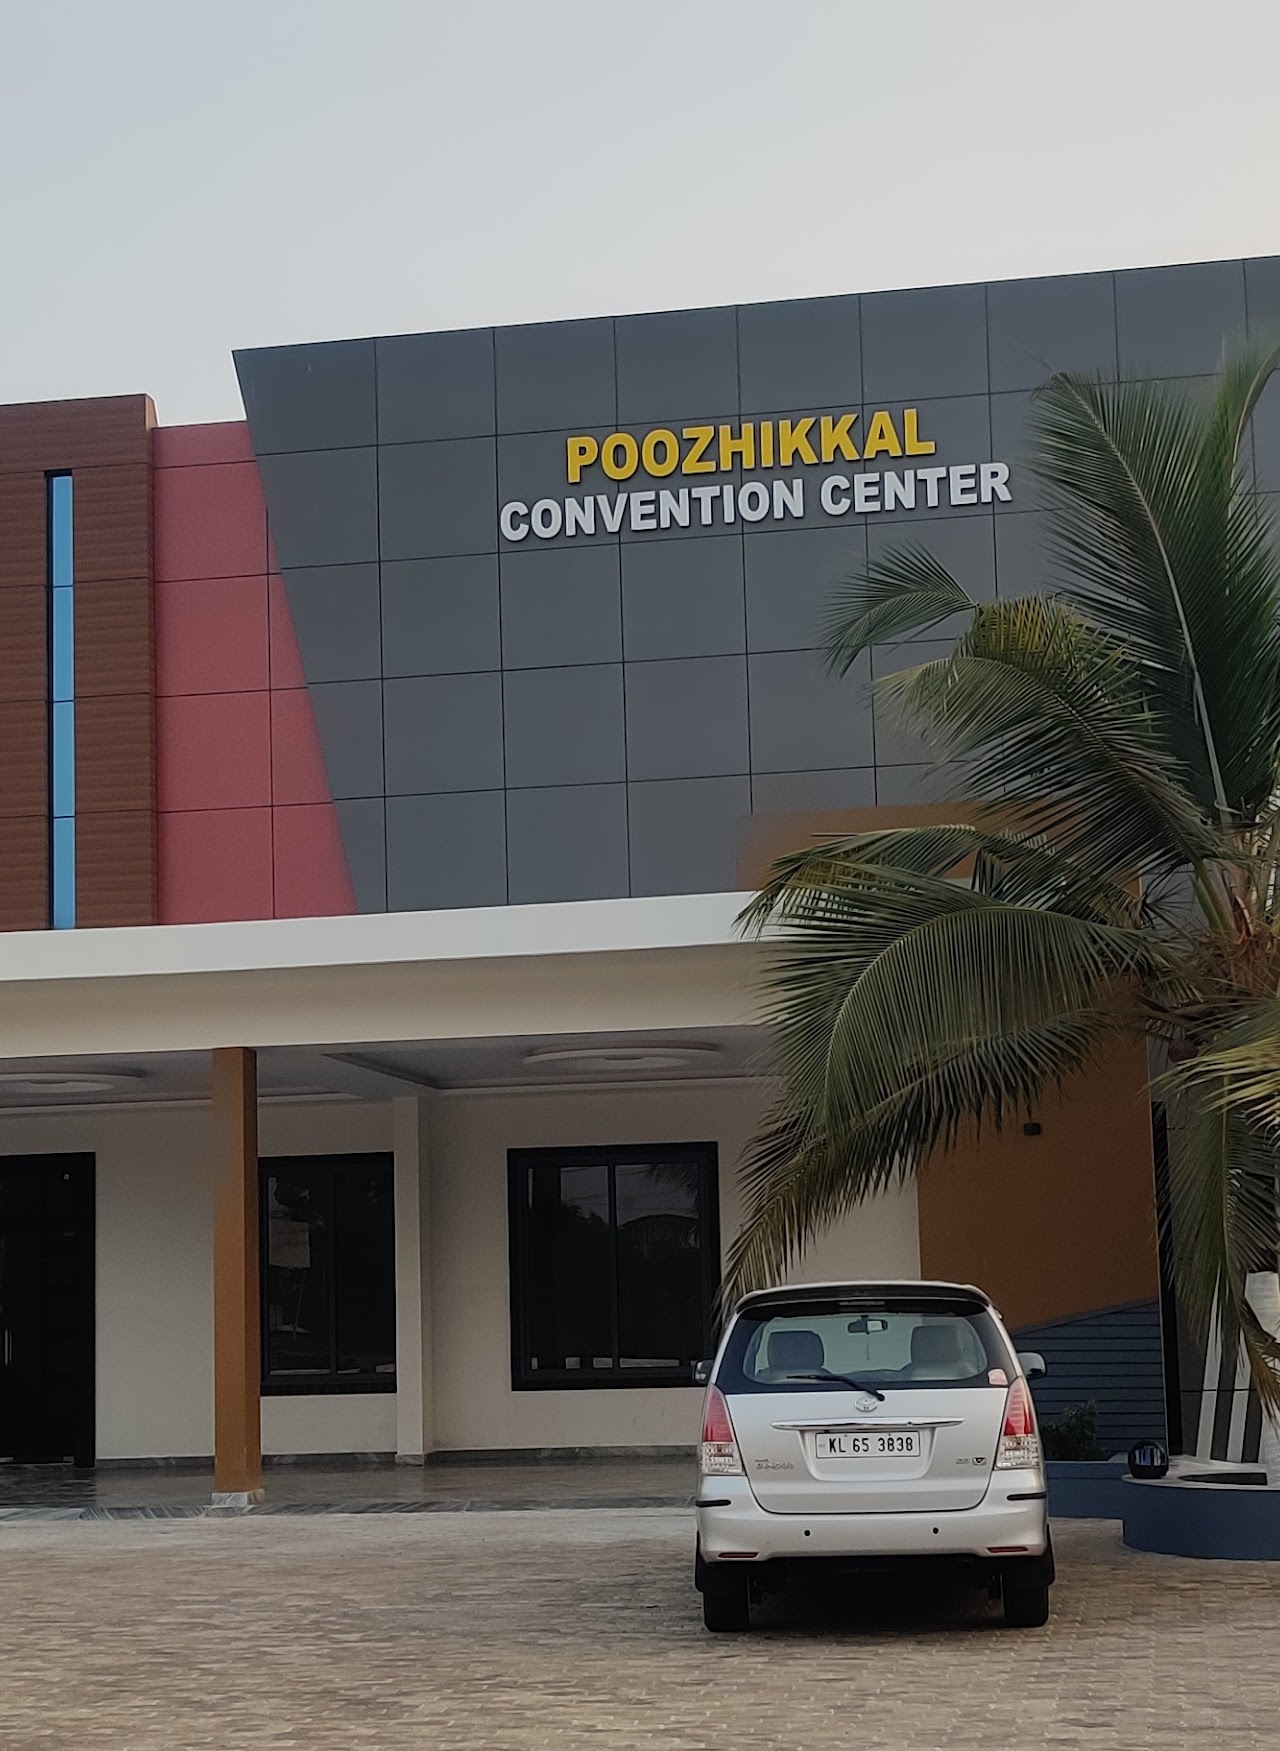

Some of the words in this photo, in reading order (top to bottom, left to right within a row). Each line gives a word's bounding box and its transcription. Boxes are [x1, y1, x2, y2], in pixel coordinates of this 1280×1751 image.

[566, 409, 936, 482] POOZHIKKAL
[500, 478, 804, 542] CONVENTION
[821, 462, 1013, 515] CENTER
[829, 1438, 846, 1453] KL
[852, 1438, 869, 1453] 65
[877, 1437, 913, 1452] 3838
